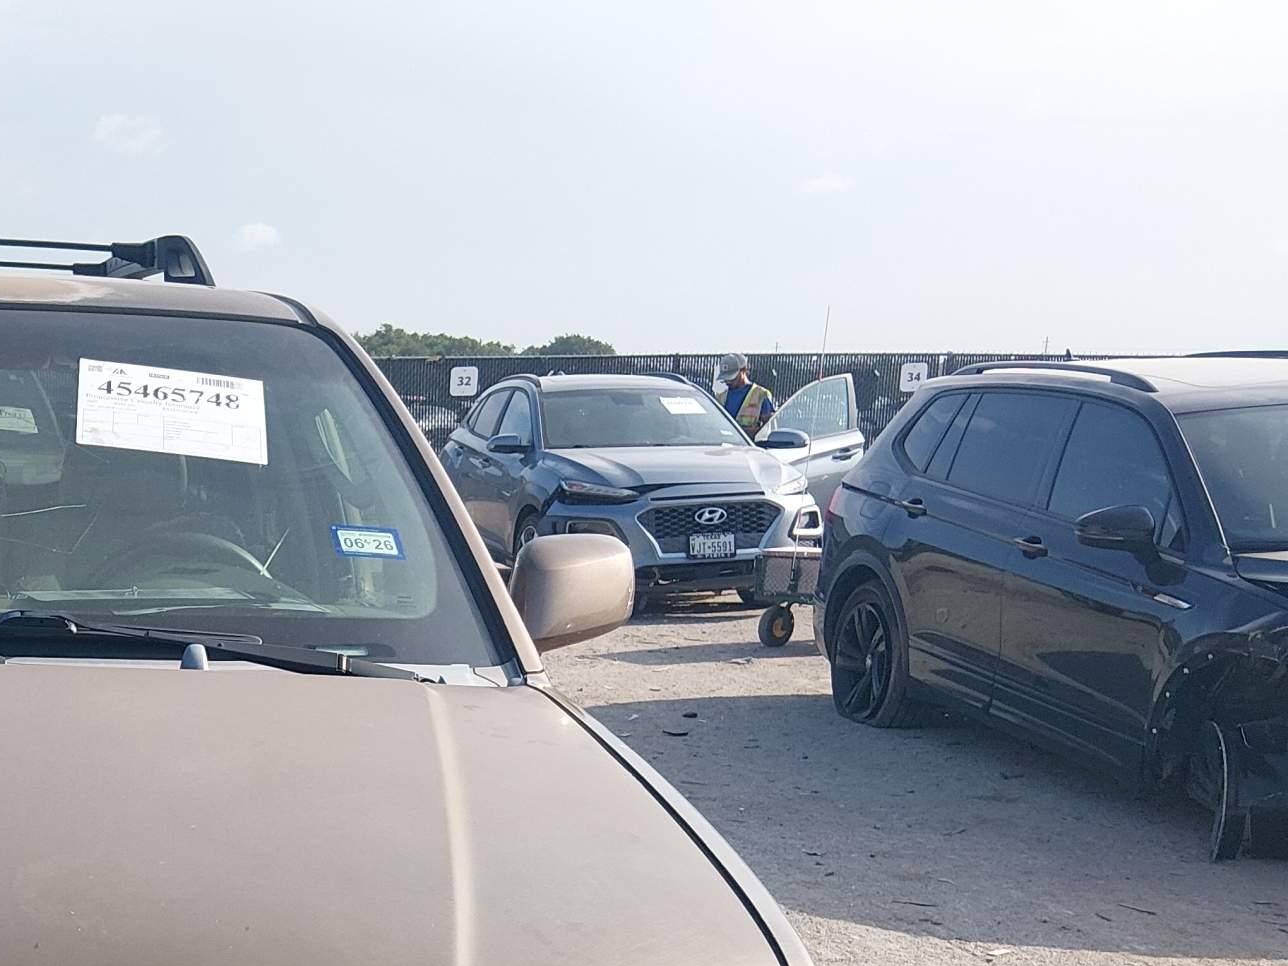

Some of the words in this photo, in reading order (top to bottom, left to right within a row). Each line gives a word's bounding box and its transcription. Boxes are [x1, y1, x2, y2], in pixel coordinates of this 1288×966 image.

[457, 376, 472, 386] 32
[907, 372, 921, 382] 34
[98, 380, 240, 410] 45465748
[372, 539, 394, 551] 26
